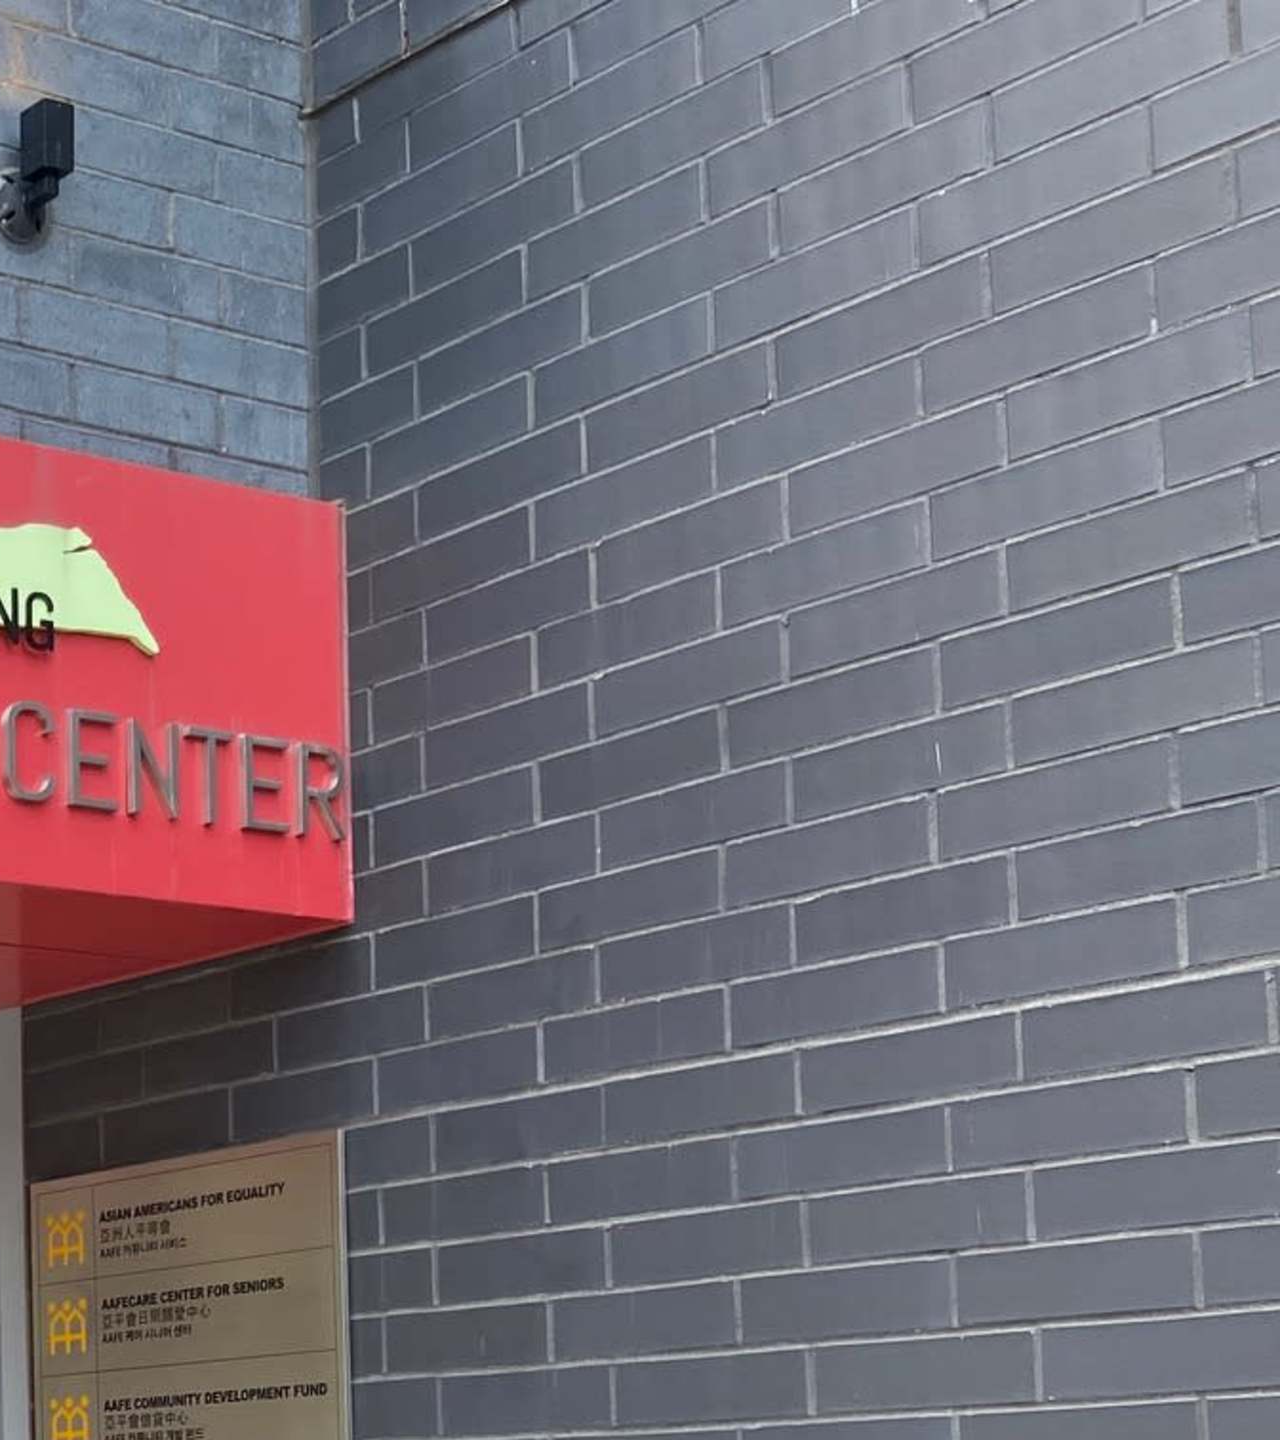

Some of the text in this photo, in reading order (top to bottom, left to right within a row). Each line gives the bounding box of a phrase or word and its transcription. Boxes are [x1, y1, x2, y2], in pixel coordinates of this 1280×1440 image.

[1, 701, 344, 842] CENTER
[99, 1182, 285, 1223] ASIAN AMERICANS FOR EQUALITY
[101, 1277, 285, 1310] AAFECARE CENTER FOR SENIORS
[104, 1382, 328, 1412] AAFE COMMUNITY DEVELOPMENT FUND
